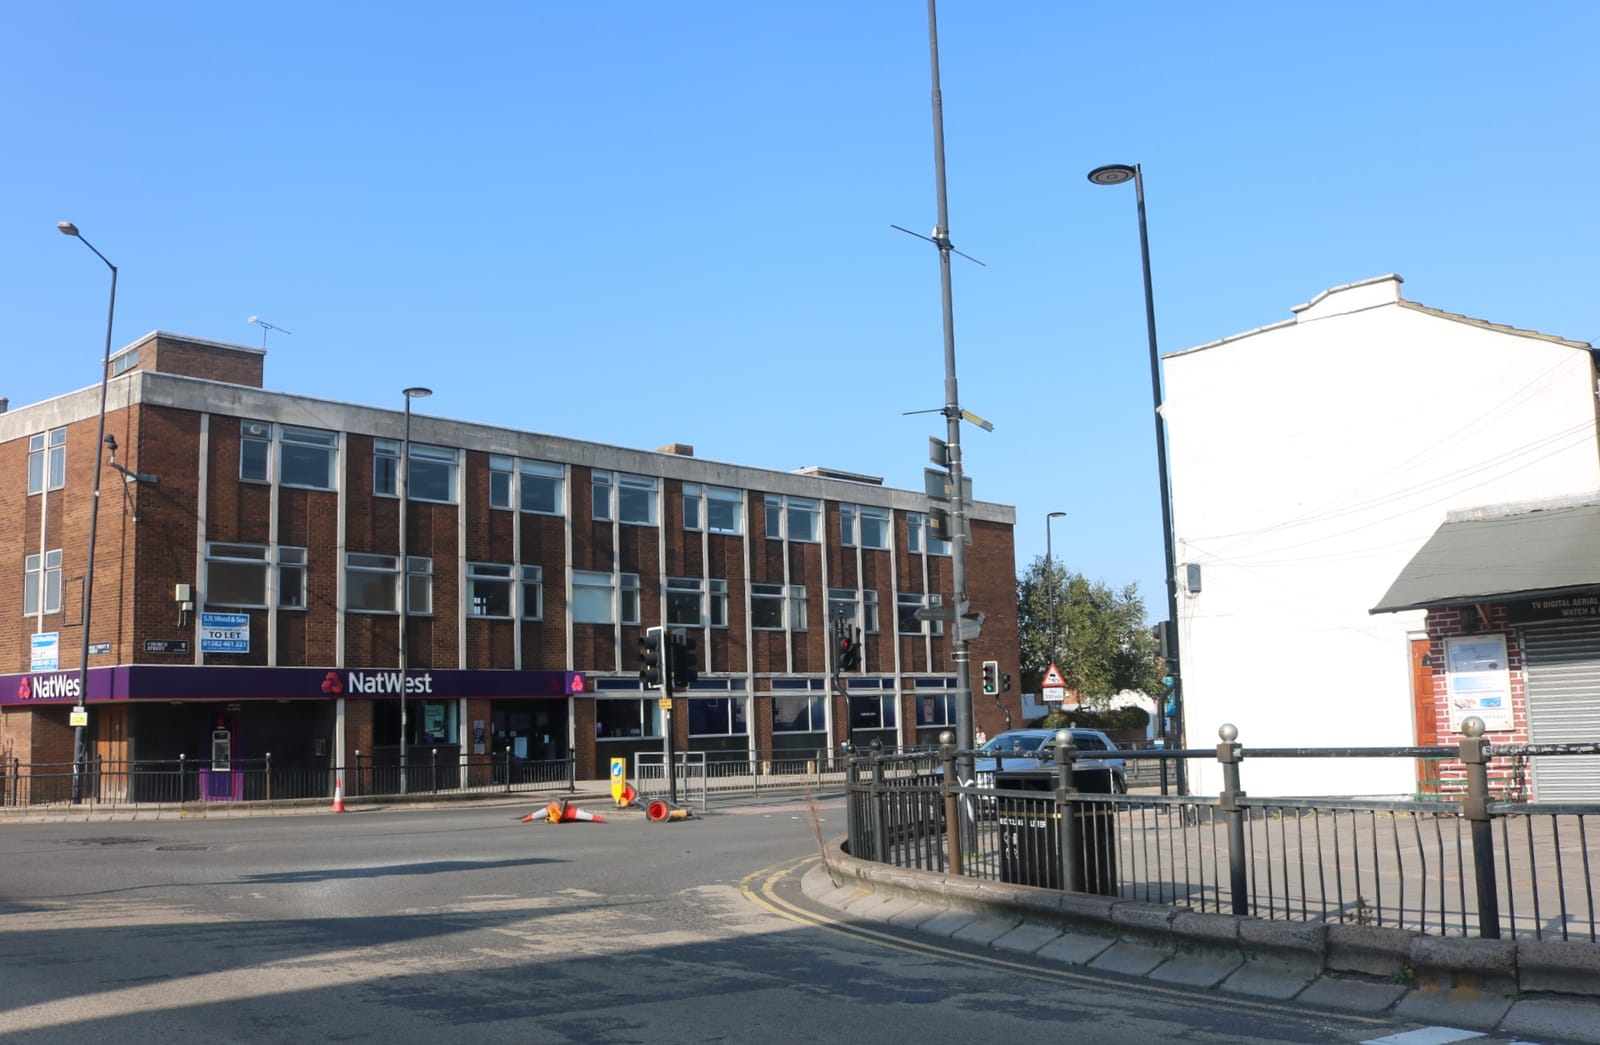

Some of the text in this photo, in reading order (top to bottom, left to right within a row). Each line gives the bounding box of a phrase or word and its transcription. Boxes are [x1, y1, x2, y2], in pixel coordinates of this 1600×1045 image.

[1543, 600, 1570, 608] DIGITAL
[1561, 608, 1588, 616] WATCH
[209, 631, 242, 640] TO LET
[33, 675, 81, 699] NatWes
[348, 672, 433, 693] NatWest
